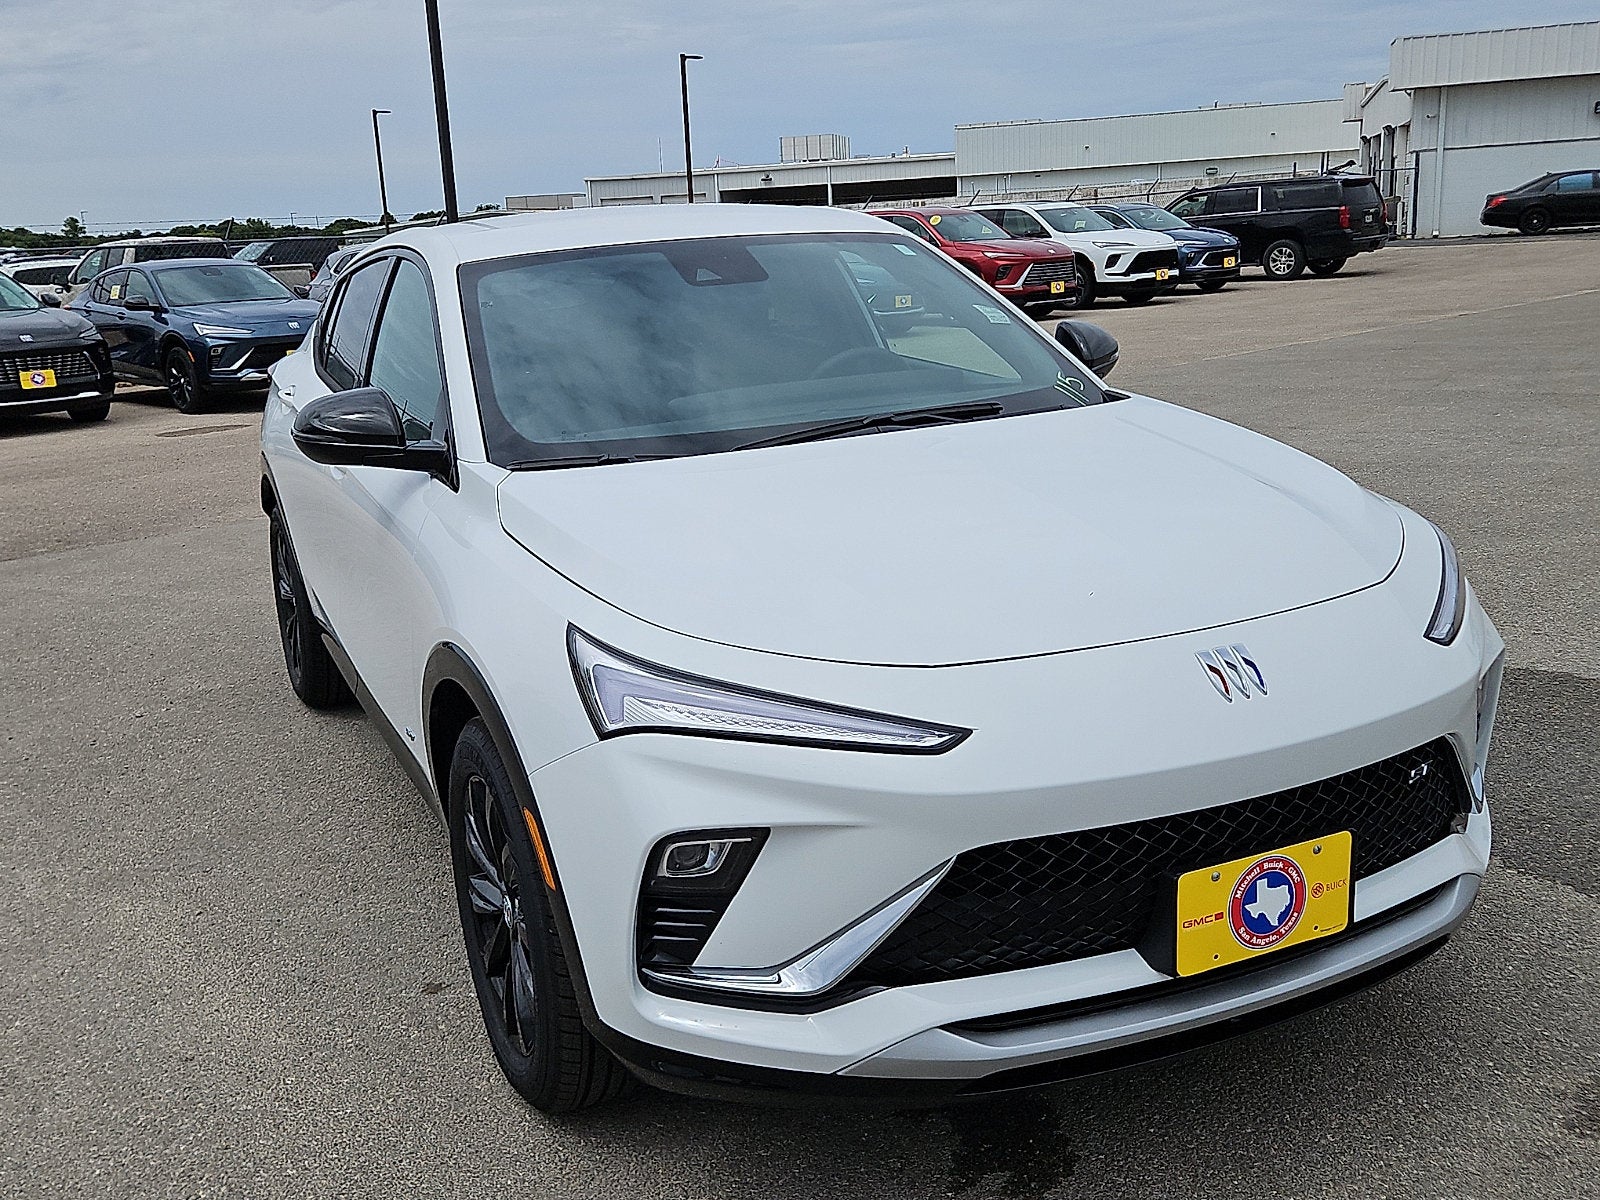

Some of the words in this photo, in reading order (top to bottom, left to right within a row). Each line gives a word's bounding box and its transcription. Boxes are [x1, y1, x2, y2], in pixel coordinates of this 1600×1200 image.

[1235, 867, 1260, 899] Mitchell
[1263, 861, 1284, 870] Buick
[1288, 867, 1300, 883] GMC
[1326, 879, 1347, 892] BUICK
[1183, 914, 1213, 929] GMC
[1238, 927, 1250, 941] San
[1250, 935, 1280, 946] Angelo,
[1280, 911, 1298, 934] Texas
